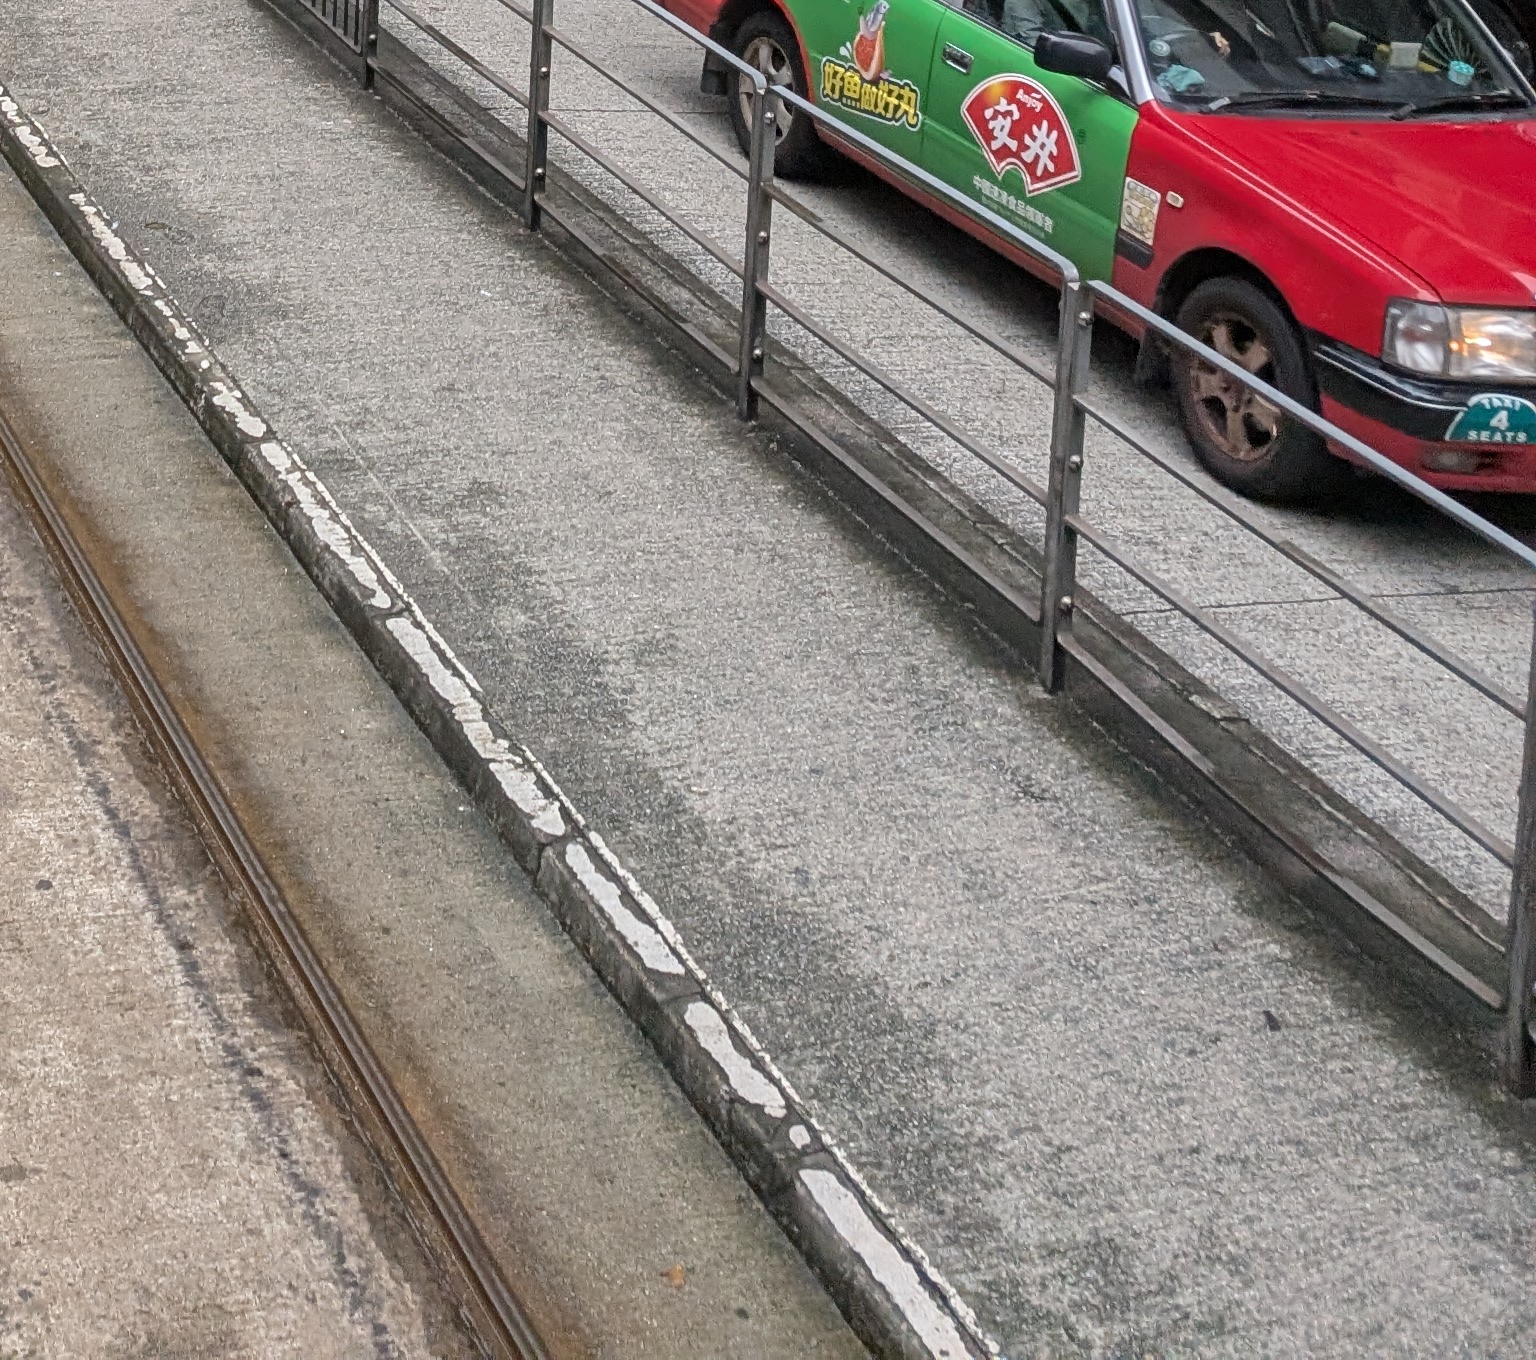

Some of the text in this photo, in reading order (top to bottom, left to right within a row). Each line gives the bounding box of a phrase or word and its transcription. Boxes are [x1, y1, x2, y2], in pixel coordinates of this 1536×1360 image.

[983, 95, 1059, 178] 安井
[1489, 409, 1510, 431] 4
[1467, 430, 1528, 443] SEATS
